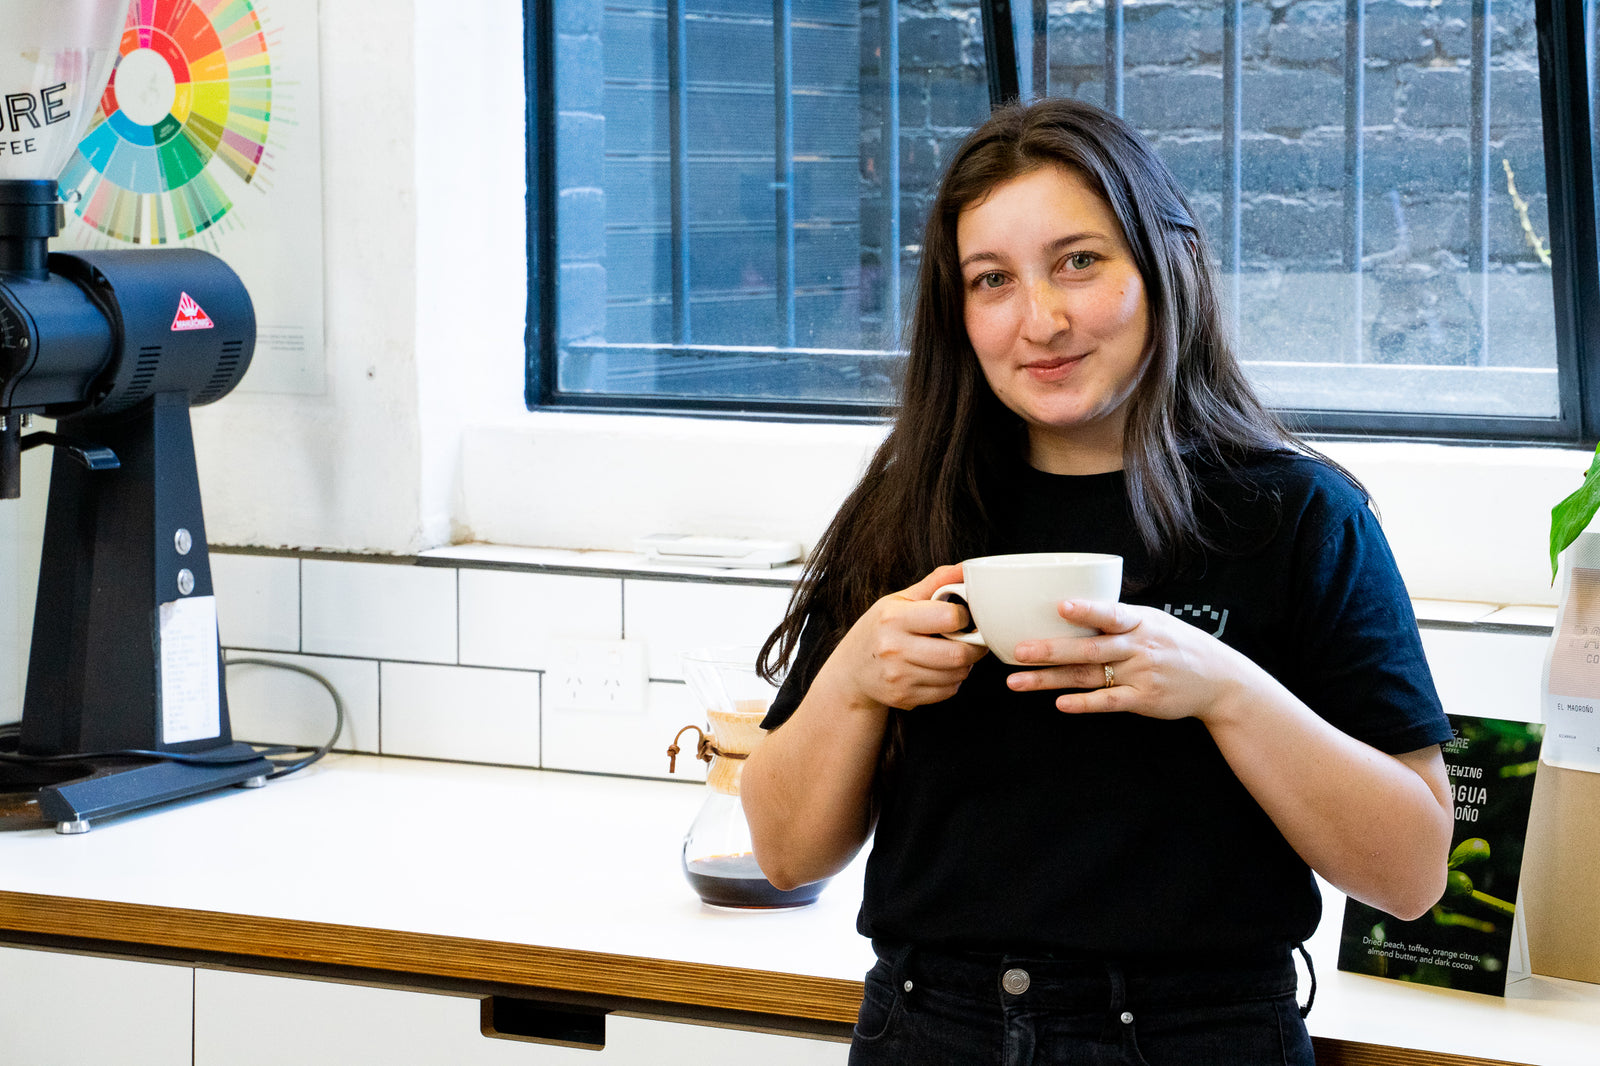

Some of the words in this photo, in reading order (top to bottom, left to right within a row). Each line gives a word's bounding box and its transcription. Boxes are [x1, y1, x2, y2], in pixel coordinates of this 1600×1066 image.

[0, 82, 71, 132] RE
[1362, 936, 1382, 946] Dried
[1383, 941, 1406, 951] peach,
[1408, 943, 1431, 955] toffee,
[1432, 948, 1458, 960] orange
[1459, 951, 1481, 963] citrus,
[1367, 947, 1394, 958] almond
[1395, 950, 1418, 963] butter,
[1419, 956, 1434, 964] and
[1434, 957, 1450, 967] dark
[1451, 961, 1474, 971] cocoa
